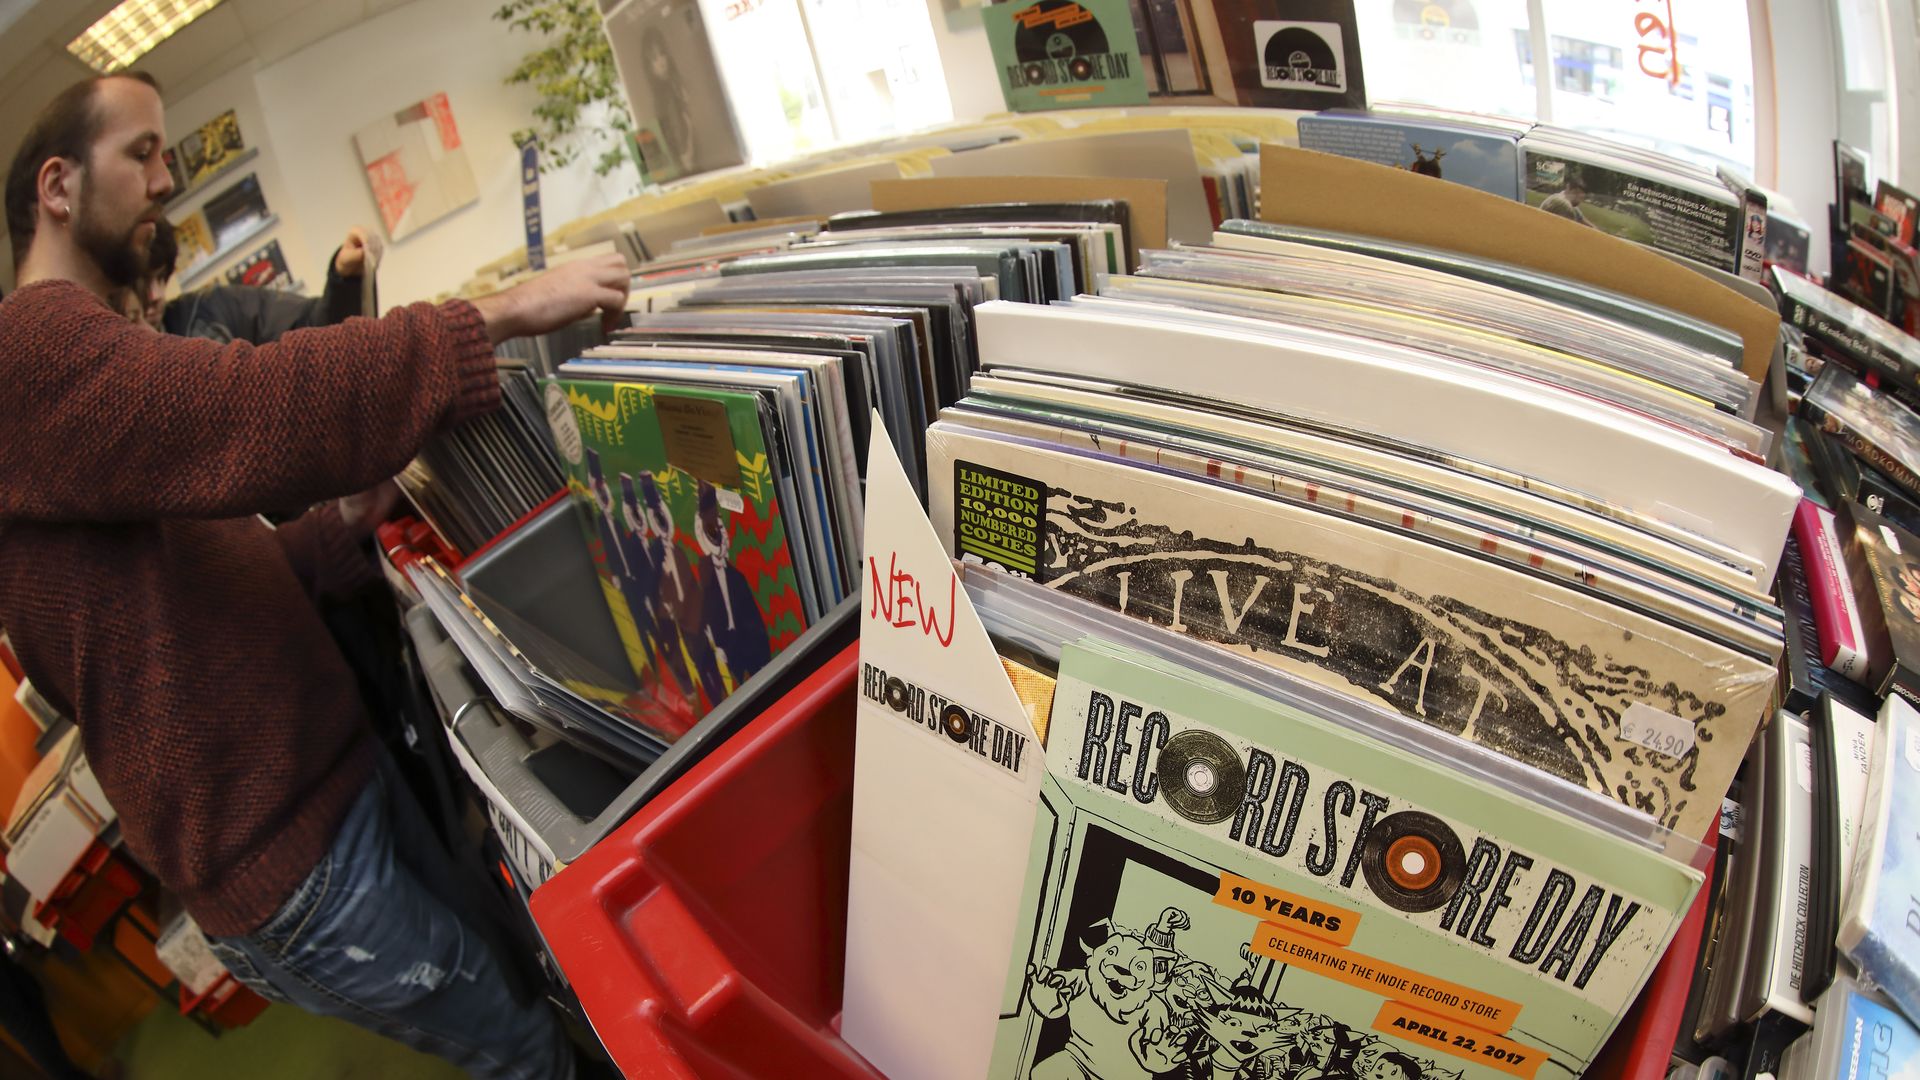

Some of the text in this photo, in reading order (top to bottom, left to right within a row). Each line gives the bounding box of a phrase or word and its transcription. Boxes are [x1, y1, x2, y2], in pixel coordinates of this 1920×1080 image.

[1106, 52, 1131, 79] DAY
[960, 469, 1039, 501] LIMITED
[960, 482, 1039, 516] EDITION
[960, 509, 1037, 543] NUMBERED
[961, 498, 1037, 528] 10,000
[960, 523, 1037, 557] COPIES
[869, 551, 956, 648] NEW
[1117, 569, 1508, 741] LIVE AT
[863, 662, 1027, 774] RECORD STORE DAY
[1858, 731, 1868, 776] TANDER
[1076, 690, 1310, 859] RECORD
[1305, 779, 1534, 950] STORE
[1508, 876, 1642, 991] DAY
[1230, 885, 1343, 933] 10 YEARS
[1790, 864, 1810, 991] DIE HITCHCOCK COLLECTION
[1267, 936, 1503, 1021] CELEBRATING THE INDIE RECORD STORE
[1391, 1016, 1527, 1067] APRIL 22, 2017
